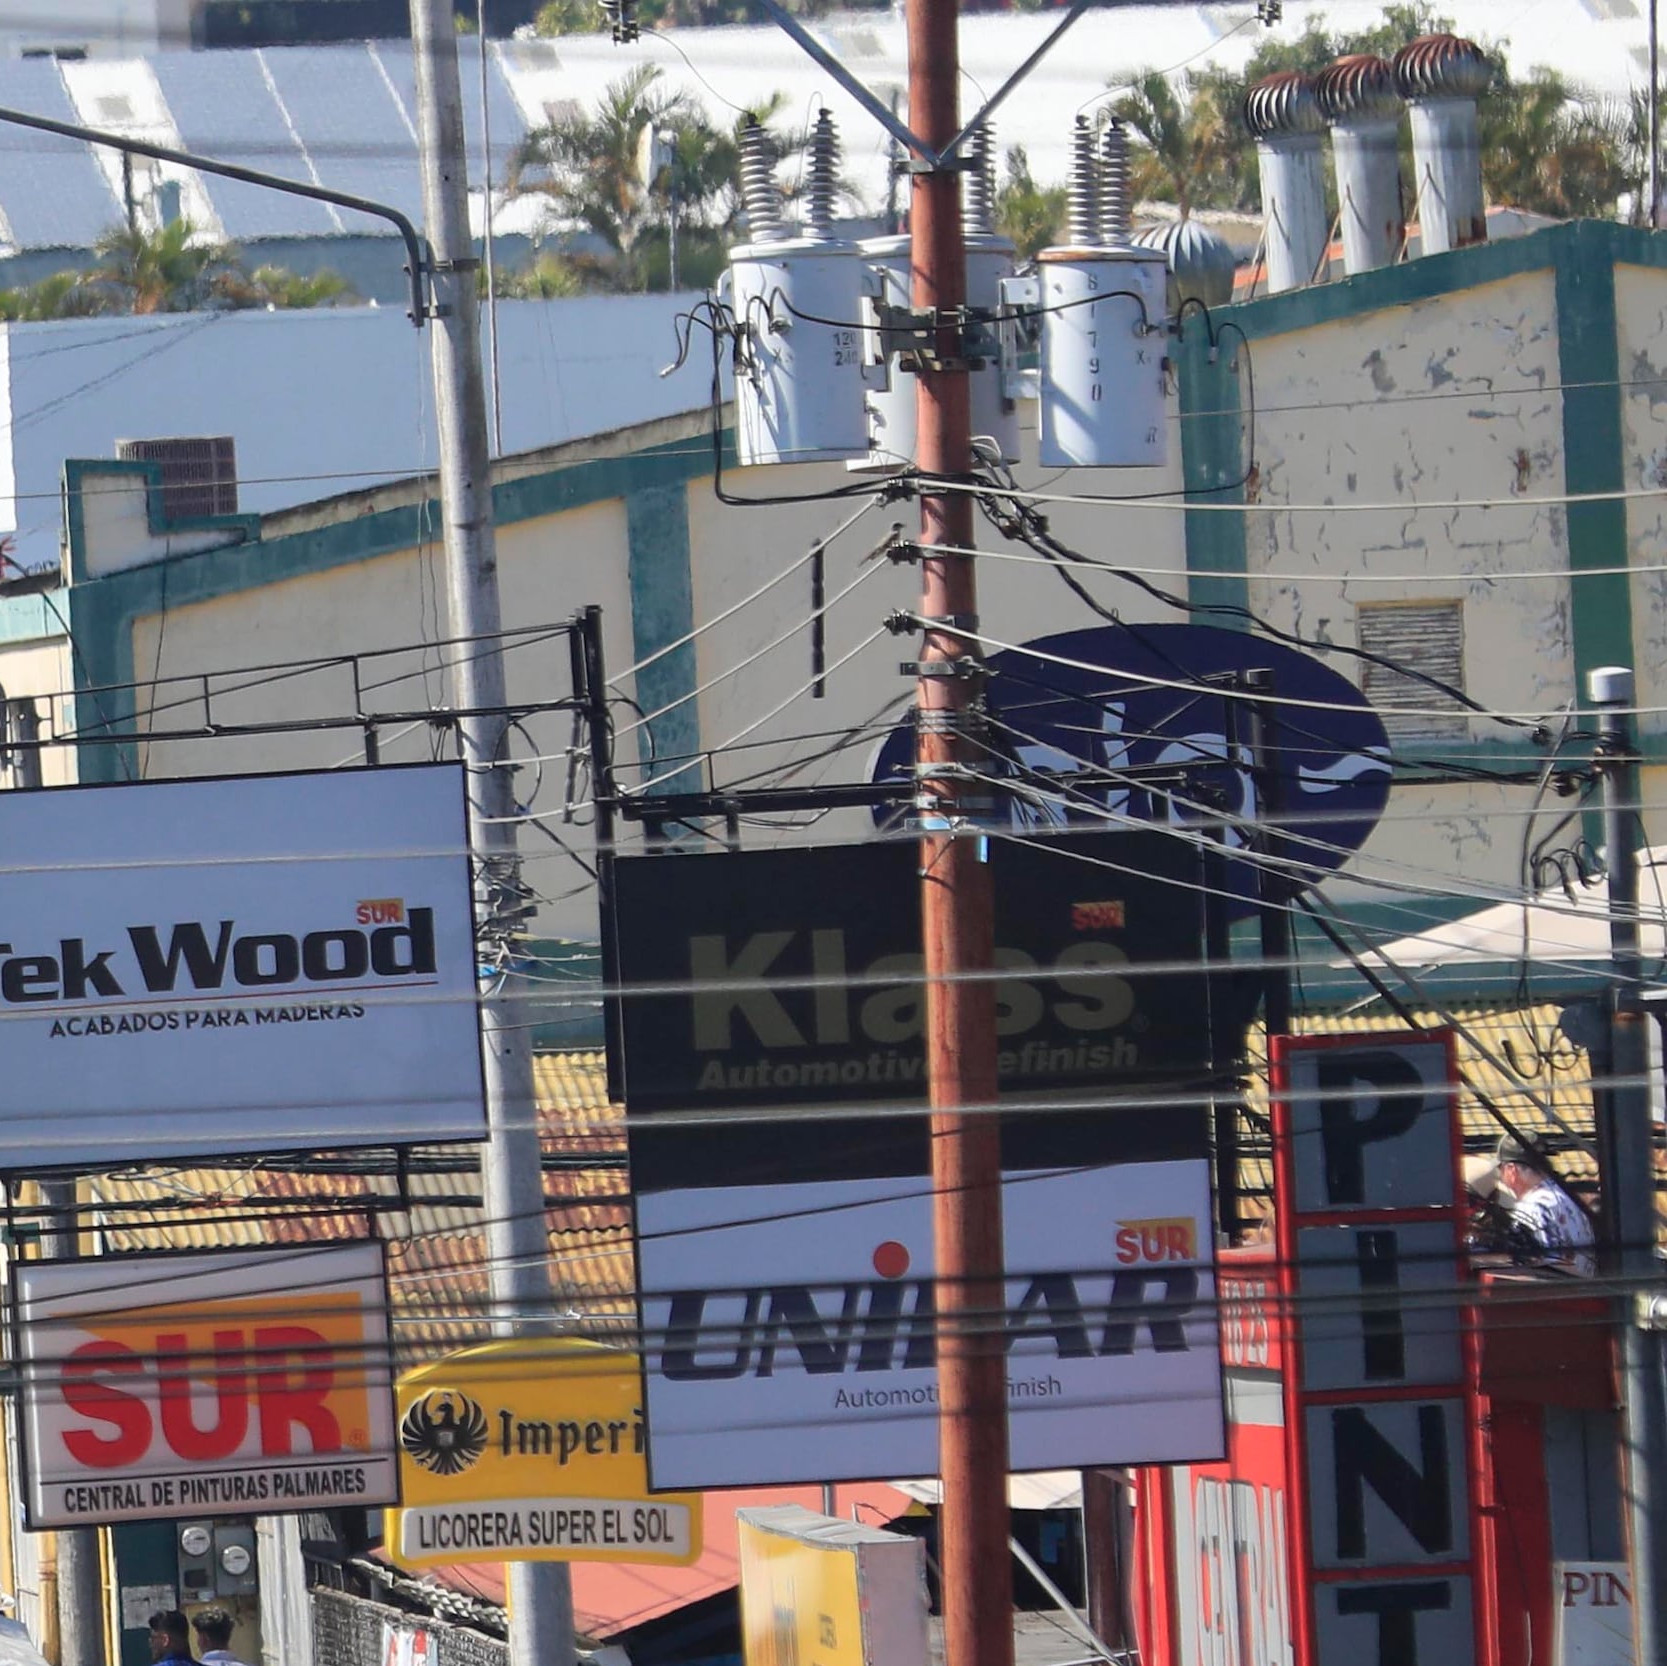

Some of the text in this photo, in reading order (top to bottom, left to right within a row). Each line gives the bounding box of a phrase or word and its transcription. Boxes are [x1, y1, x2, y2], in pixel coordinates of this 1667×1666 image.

[356, 901, 401, 924] SUR
[127, 907, 437, 992] Wood
[49, 1000, 365, 1039] ACABADOS PARA MADERAS
[697, 1037, 1138, 1090] Automotiv efinish
[1116, 1224, 1194, 1264] SUR
[60, 1326, 343, 1467] SUR
[835, 1384, 941, 1409] Automoti
[500, 1408, 647, 1464] Imperi
[64, 1468, 366, 1513] CENTRAL DE PINTURAS PALMARES
[418, 1508, 674, 1549] LICORERA SUPER EL SOL
